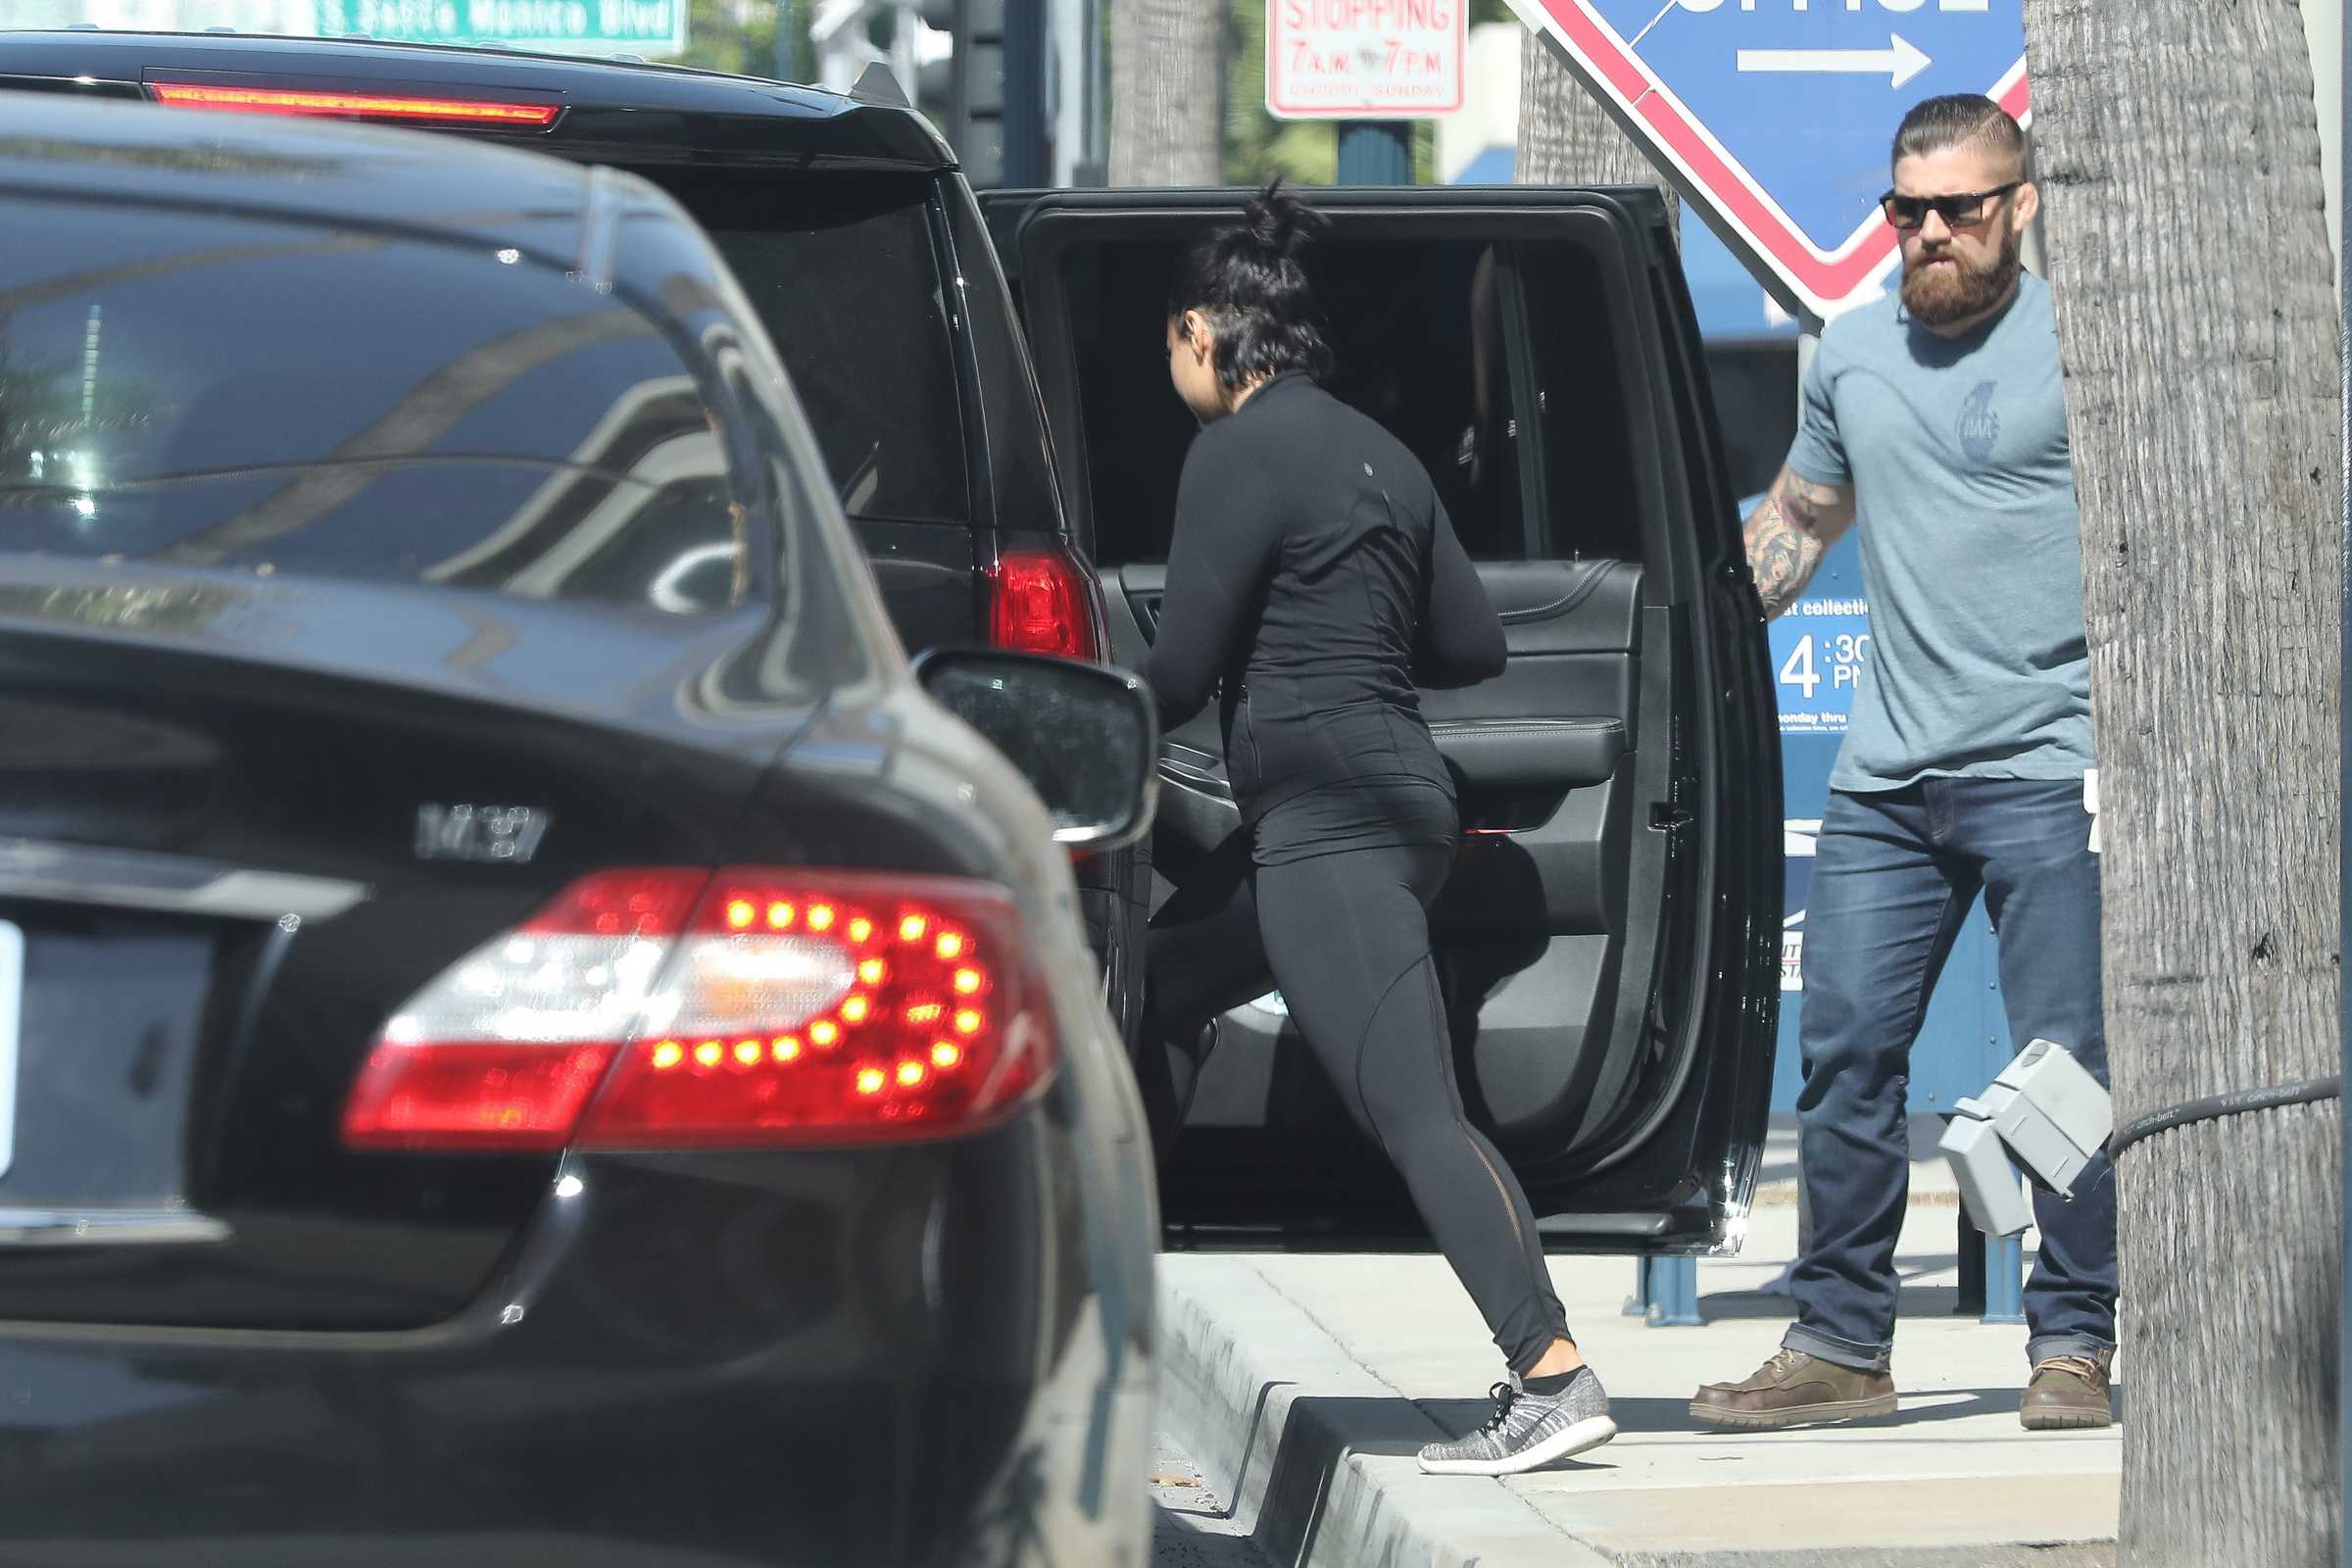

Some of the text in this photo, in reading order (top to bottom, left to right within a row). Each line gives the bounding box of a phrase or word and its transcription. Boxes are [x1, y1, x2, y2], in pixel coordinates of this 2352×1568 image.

[470, 0, 589, 35] Monica
[599, 0, 675, 36] Blvd
[1285, 0, 1450, 30] STOPPING
[1802, 599, 1869, 616] collecti
